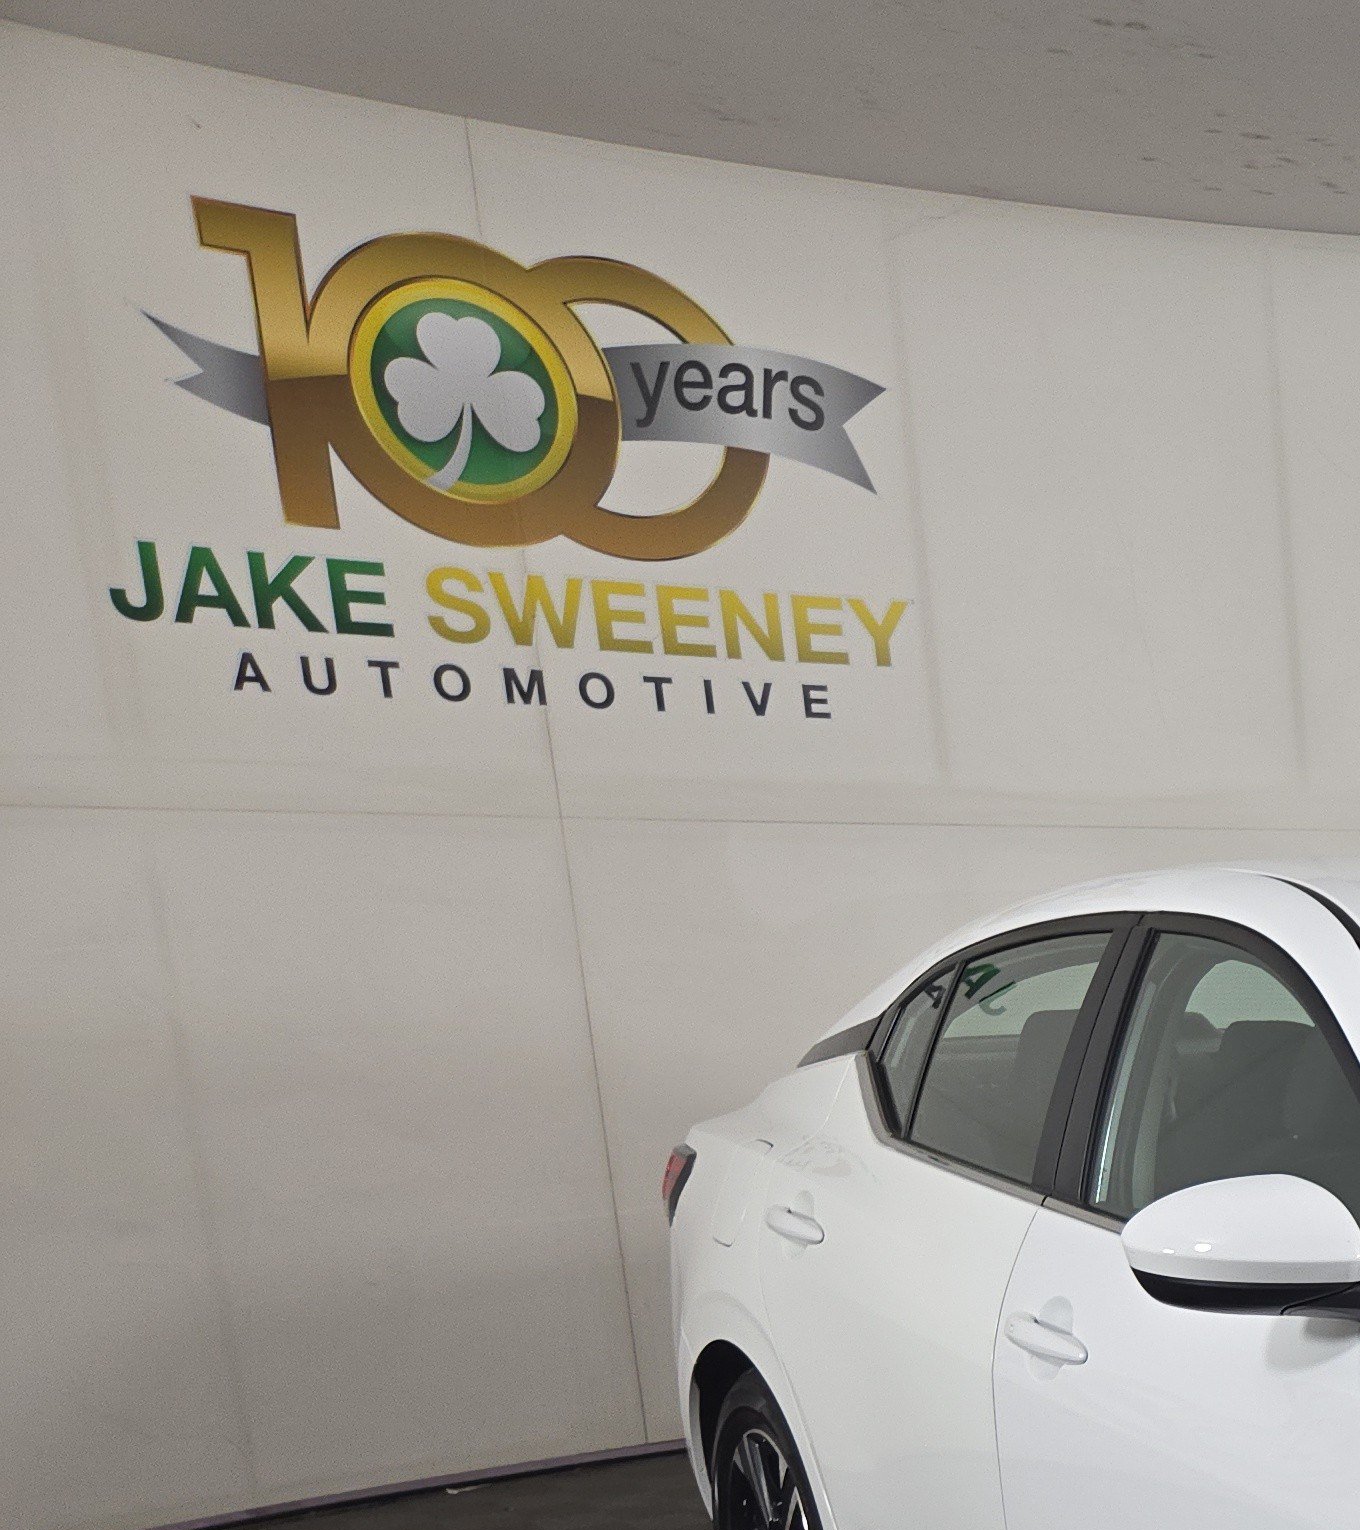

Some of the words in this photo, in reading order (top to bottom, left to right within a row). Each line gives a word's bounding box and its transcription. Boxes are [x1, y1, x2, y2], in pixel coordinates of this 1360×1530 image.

[629, 356, 827, 433] years
[109, 540, 396, 638] JAKE
[425, 566, 910, 667] SWEENEY
[233, 652, 833, 720] AUTOMOTIVE
